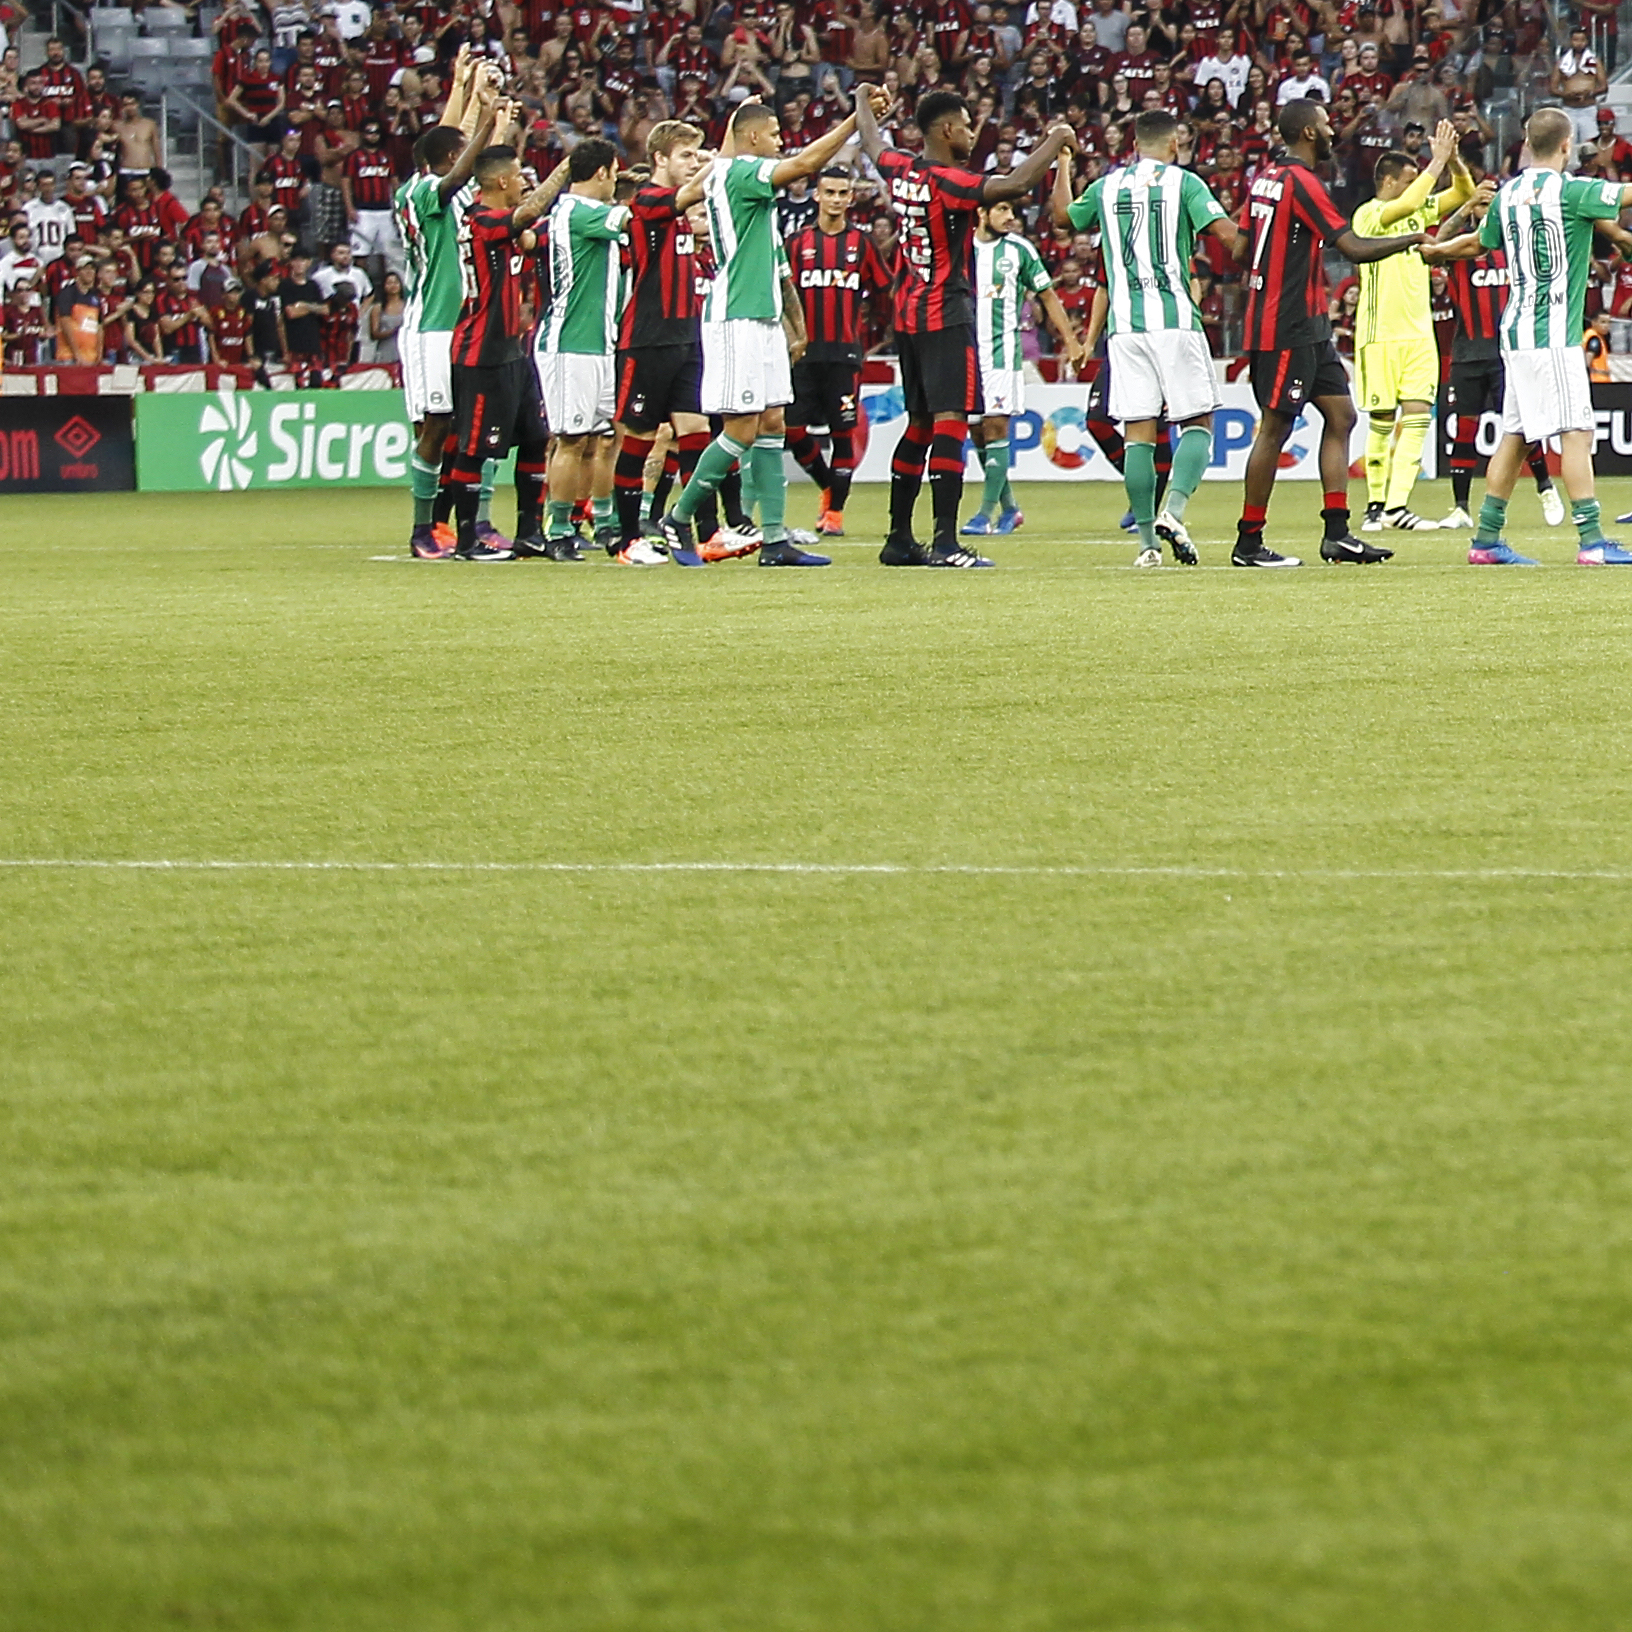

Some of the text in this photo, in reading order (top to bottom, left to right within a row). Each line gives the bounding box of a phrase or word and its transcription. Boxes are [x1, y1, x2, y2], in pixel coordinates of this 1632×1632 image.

[892, 177, 933, 203] CAIXA
[1112, 200, 1169, 266] 71
[801, 269, 860, 291] CAIXA
[1471, 268, 1512, 289] CAI
[268, 402, 412, 481] Sicre
